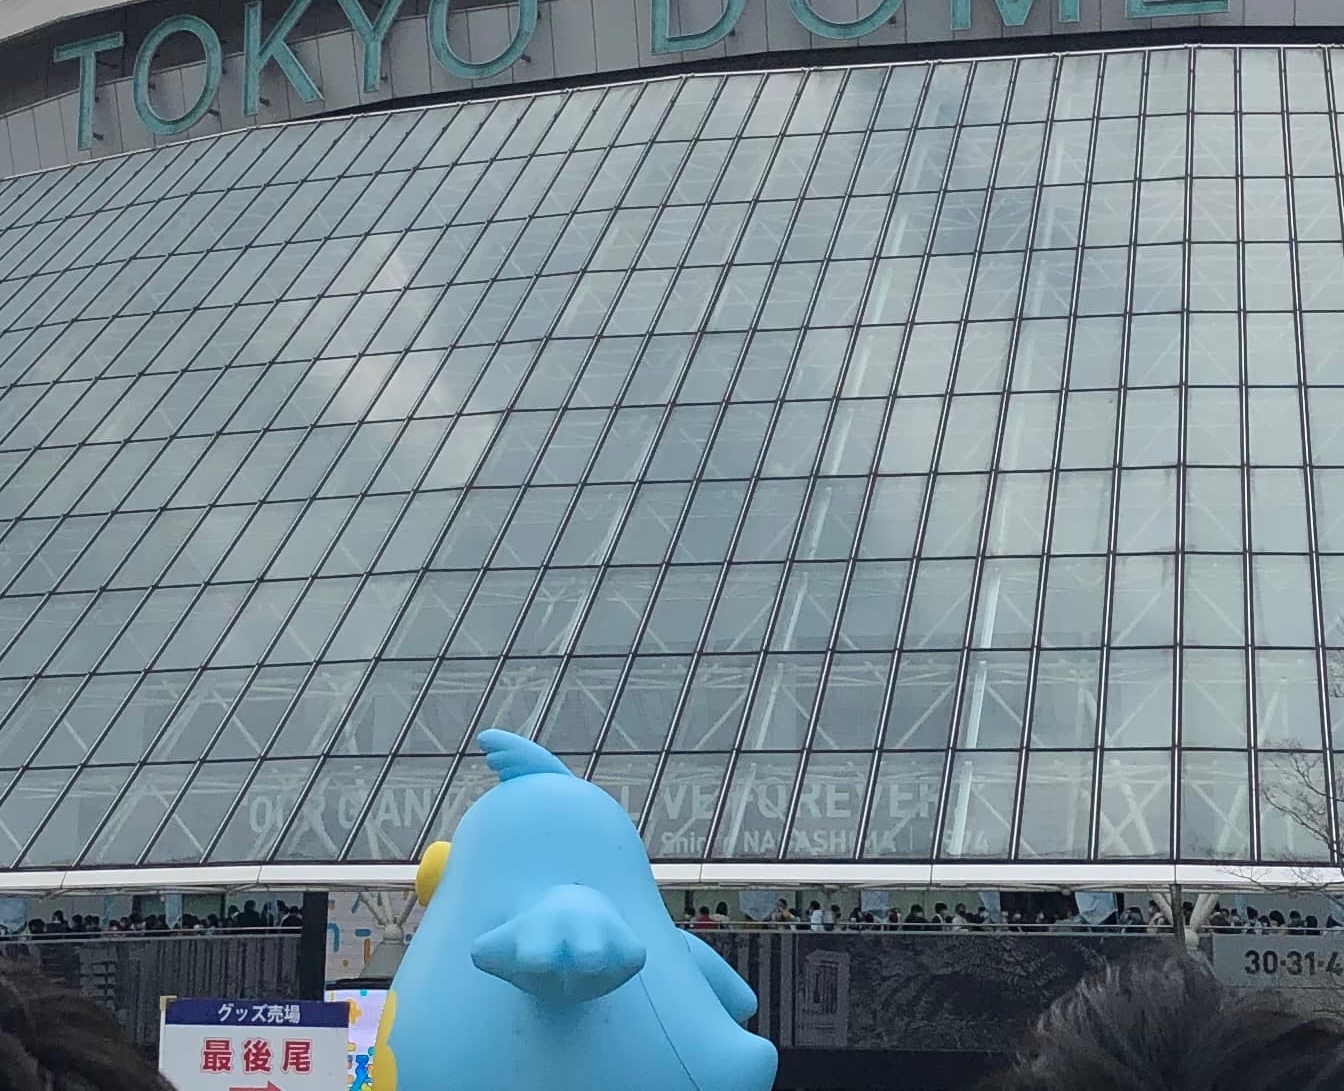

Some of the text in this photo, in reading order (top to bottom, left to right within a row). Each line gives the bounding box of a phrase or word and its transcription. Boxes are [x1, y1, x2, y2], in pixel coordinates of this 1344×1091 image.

[218, 1003, 300, 1024] グッズ売場
[200, 1038, 313, 1074] 最後尾
